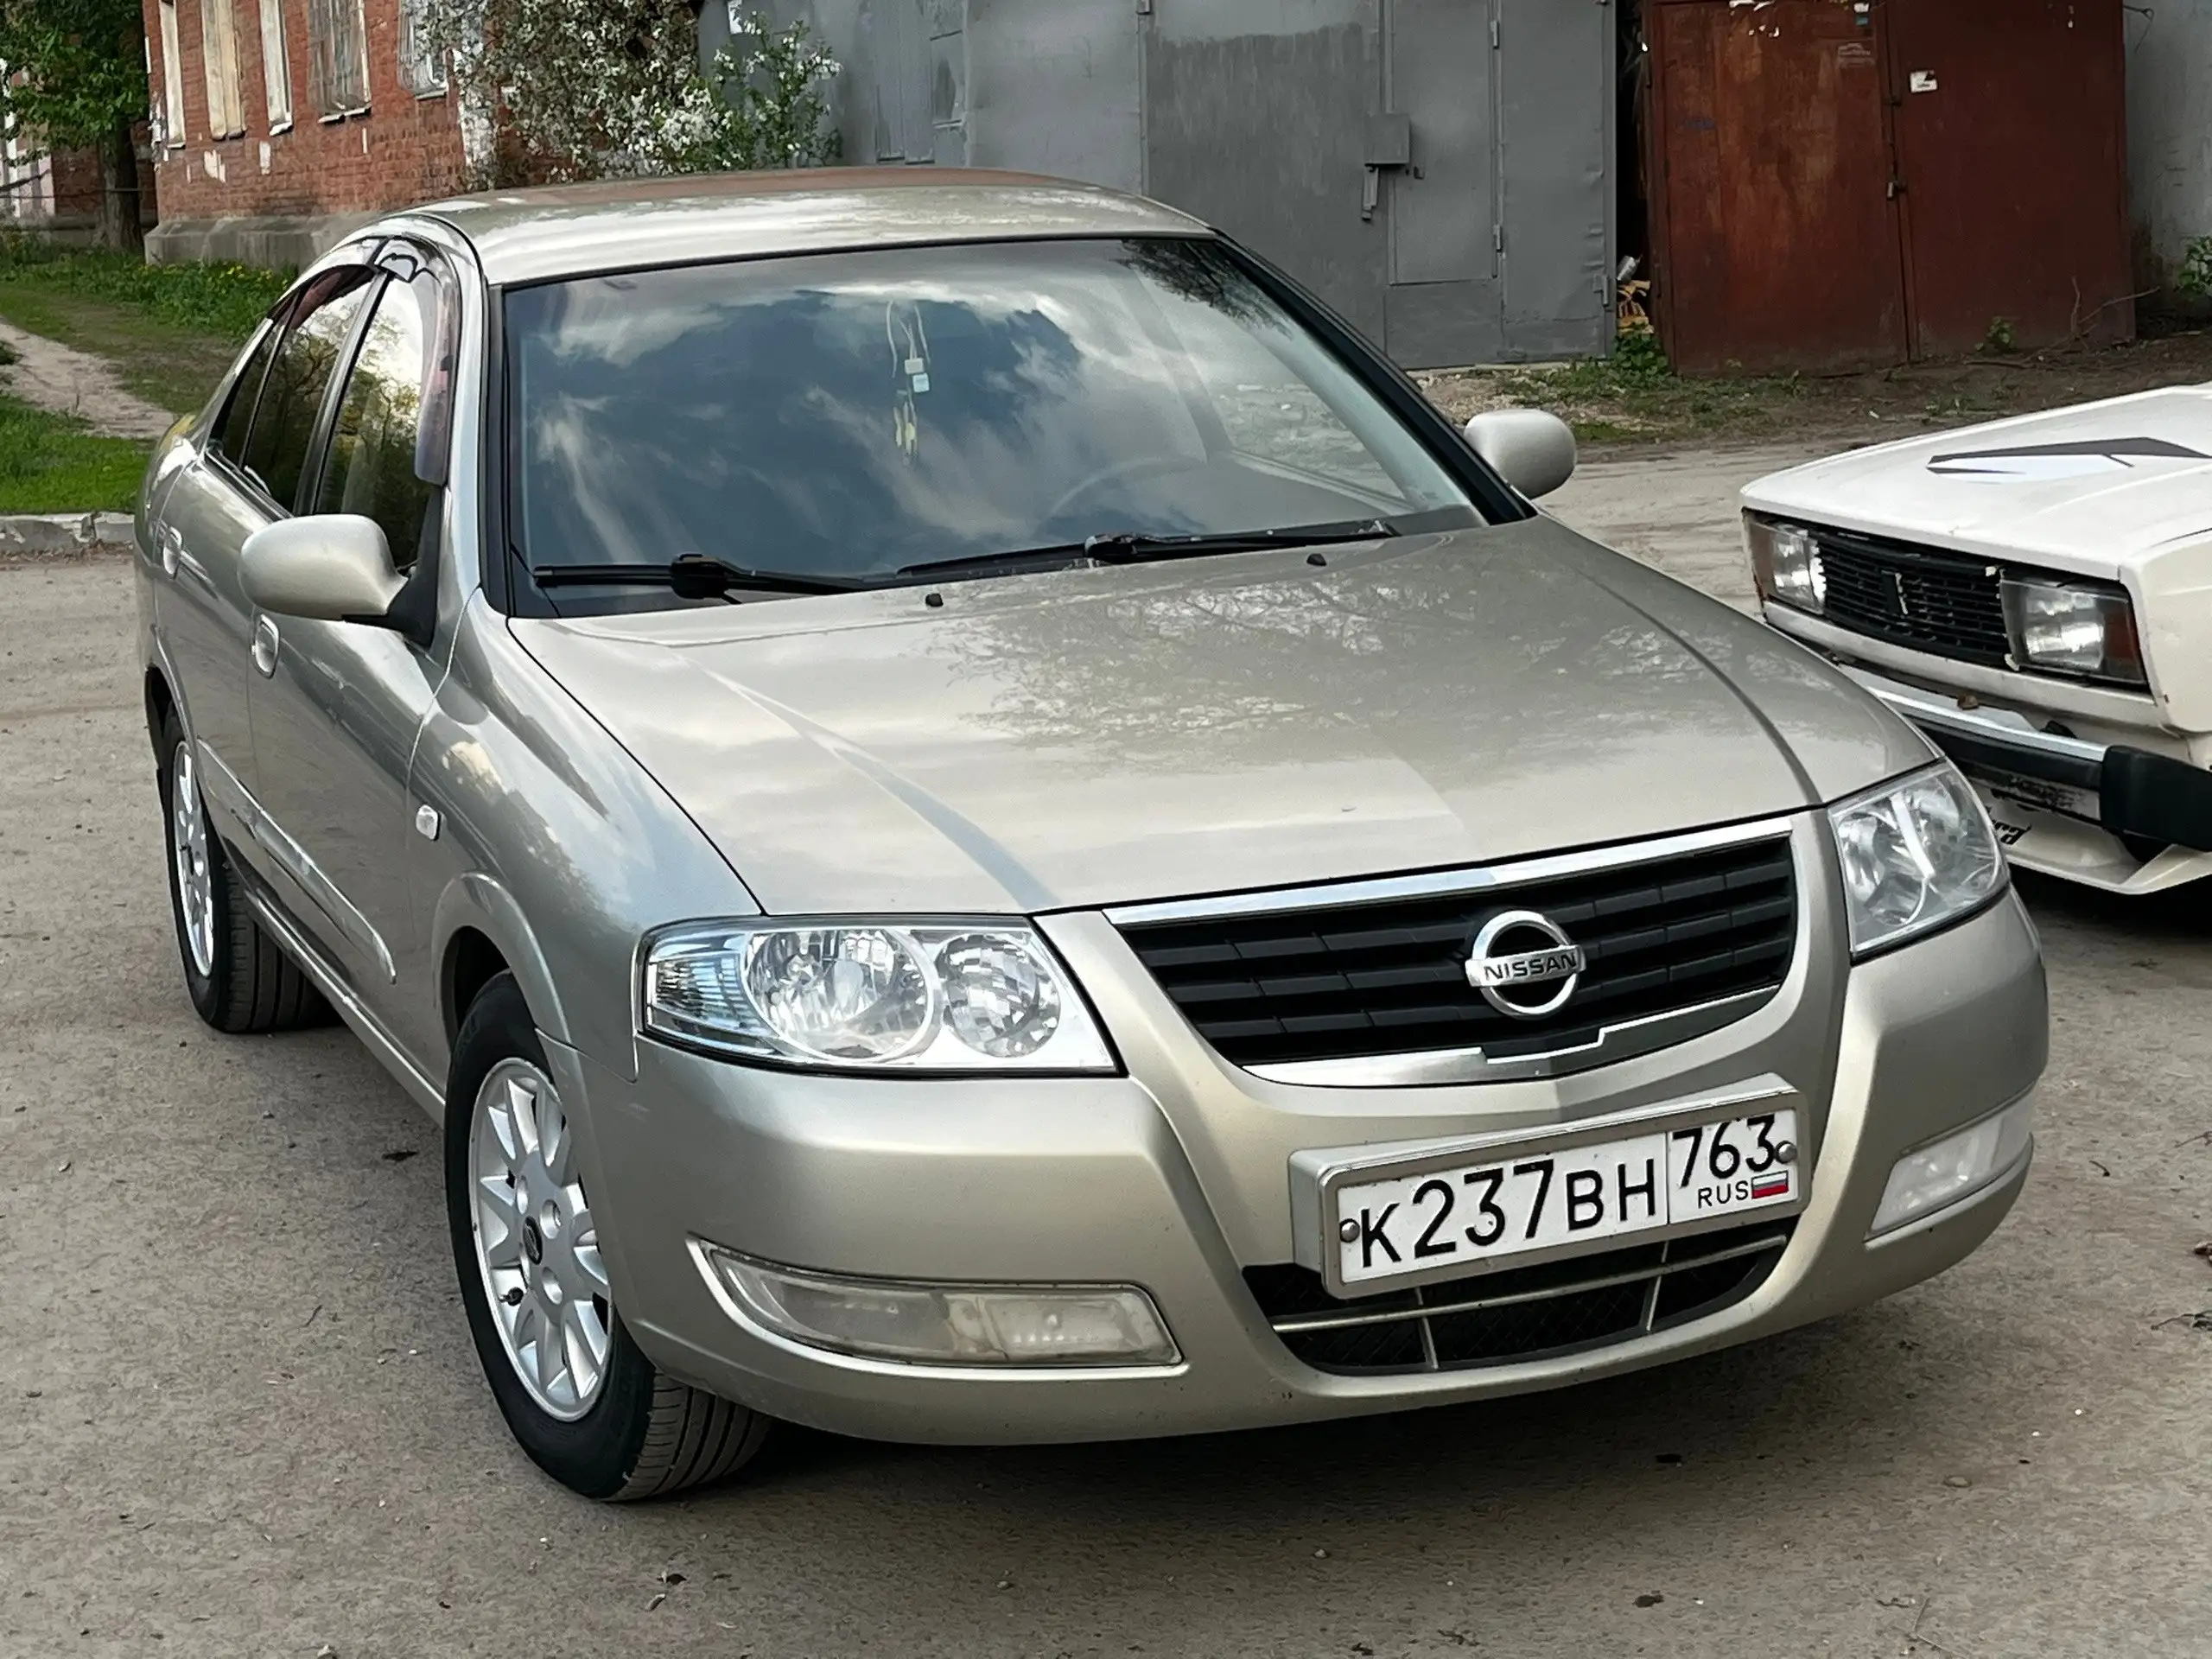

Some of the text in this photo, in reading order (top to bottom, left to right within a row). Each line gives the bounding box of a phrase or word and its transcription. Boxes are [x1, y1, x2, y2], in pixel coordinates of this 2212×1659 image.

[1484, 953, 1577, 981] NISSAN
[1671, 1114, 1777, 1189] 763
[1697, 1179, 1750, 1210] RUS
